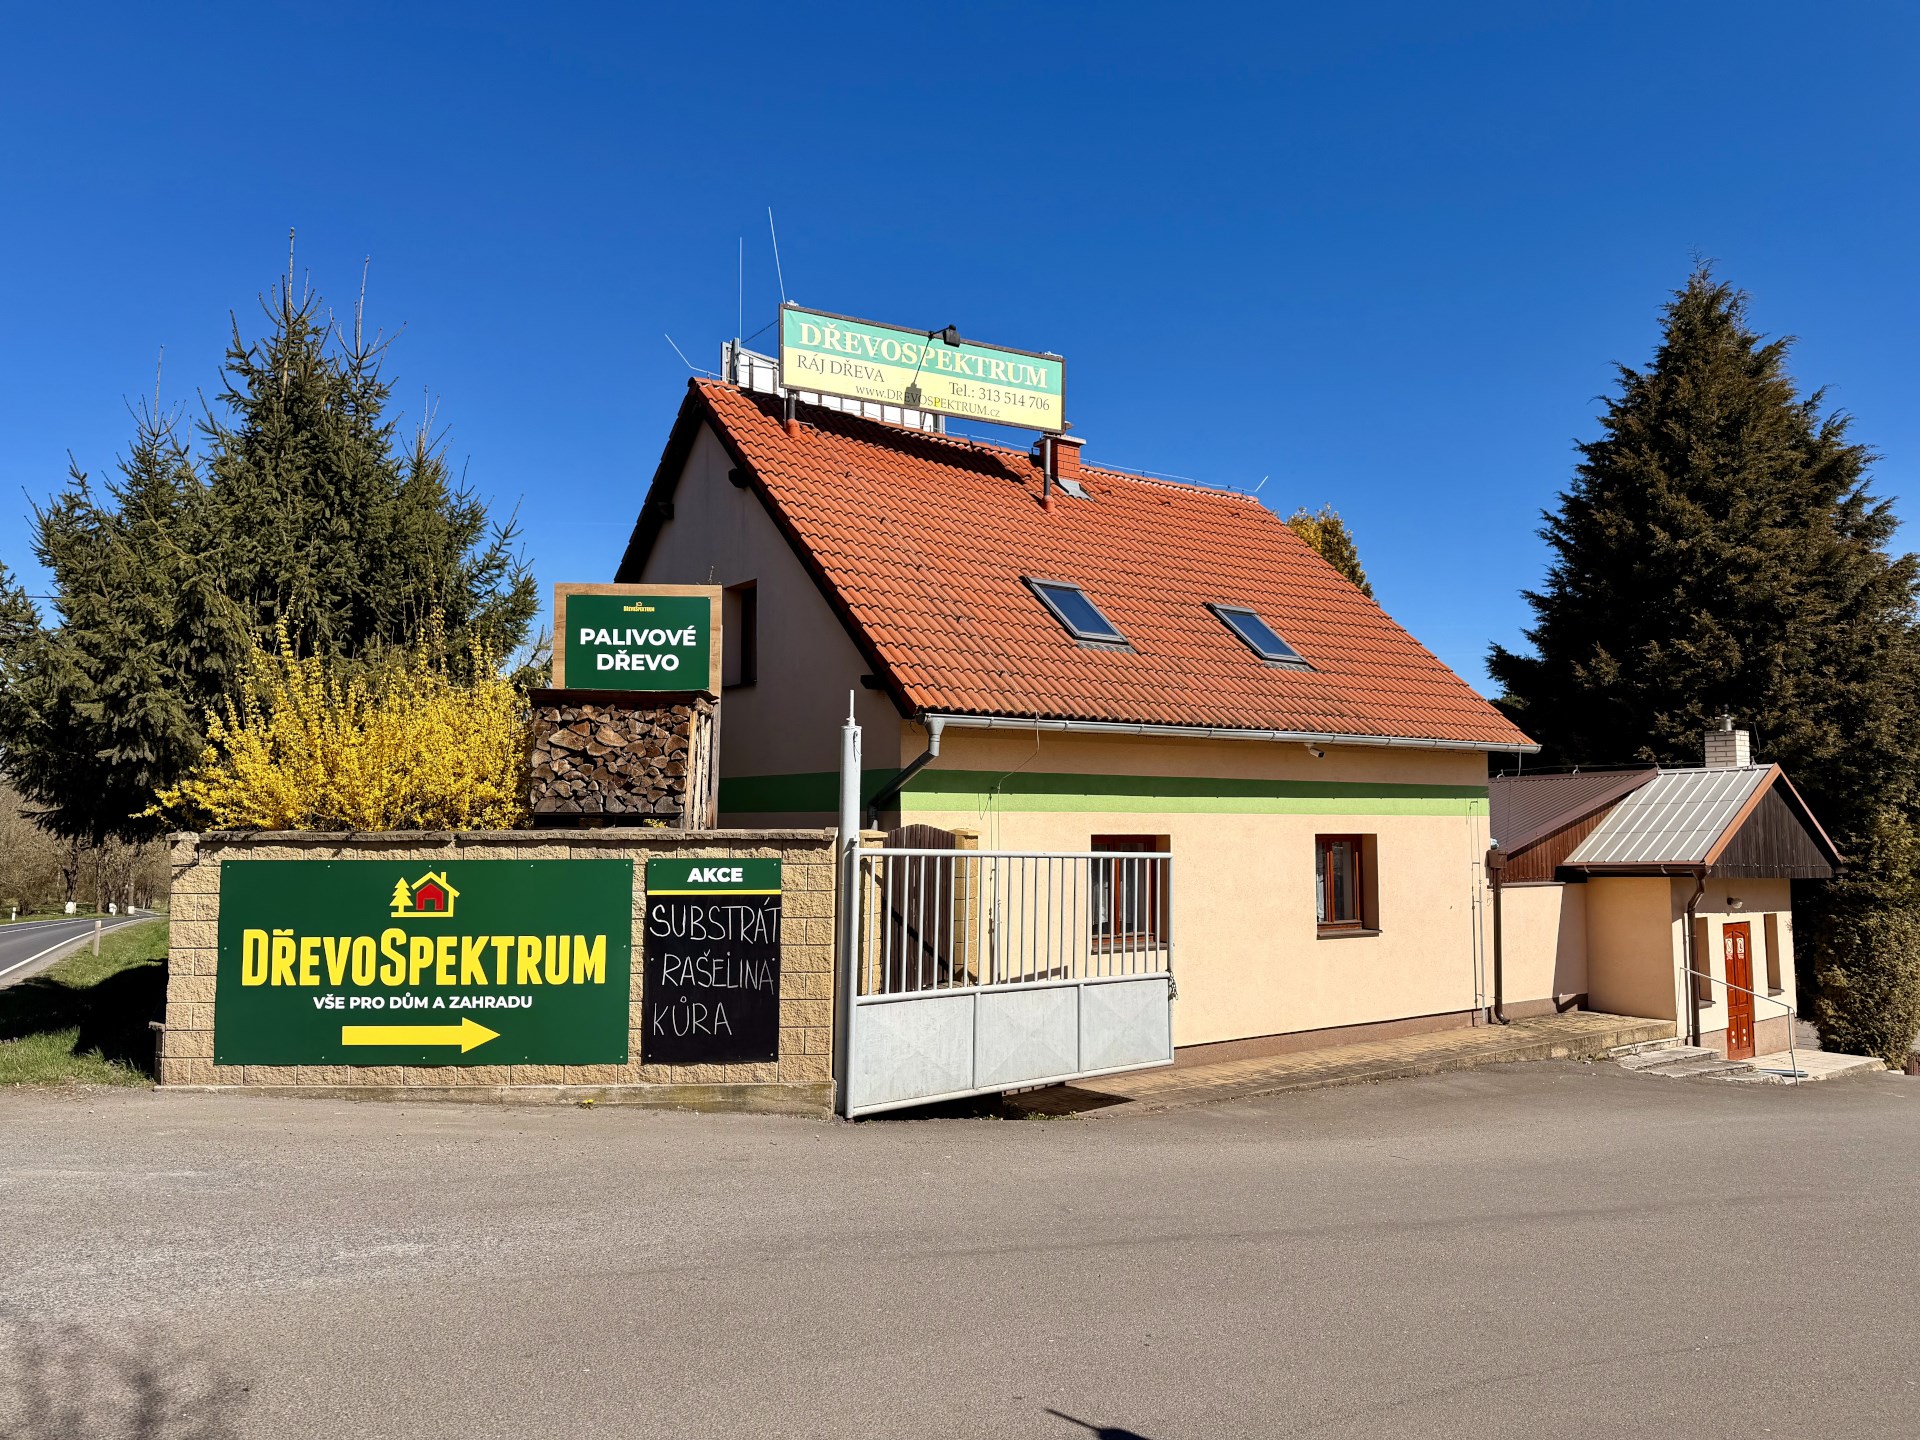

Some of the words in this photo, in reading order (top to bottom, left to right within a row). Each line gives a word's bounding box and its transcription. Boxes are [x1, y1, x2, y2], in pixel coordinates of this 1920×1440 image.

[797, 353, 824, 375] RÁJ
[830, 359, 885, 383] DŘEVA
[799, 322, 1048, 388] DŘEVOSPEKTRUM
[949, 381, 975, 398] Tel.:
[978, 387, 1001, 403] 313
[1004, 391, 1025, 407] 514
[1029, 395, 1050, 411] 706
[580, 625, 697, 647] PALIVOVÉ
[597, 650, 680, 671] DŘEVO
[687, 867, 743, 882] AKCE
[650, 897, 781, 944] SUBSTRÁT
[662, 949, 774, 995] RAŠELINA
[313, 994, 345, 1009] VŠE
[350, 996, 385, 1009] PRO
[389, 992, 428, 1009] DŮM
[432, 996, 446, 1009] A
[449, 996, 533, 1009] ZAHRADU
[653, 996, 732, 1036] KŮRA
